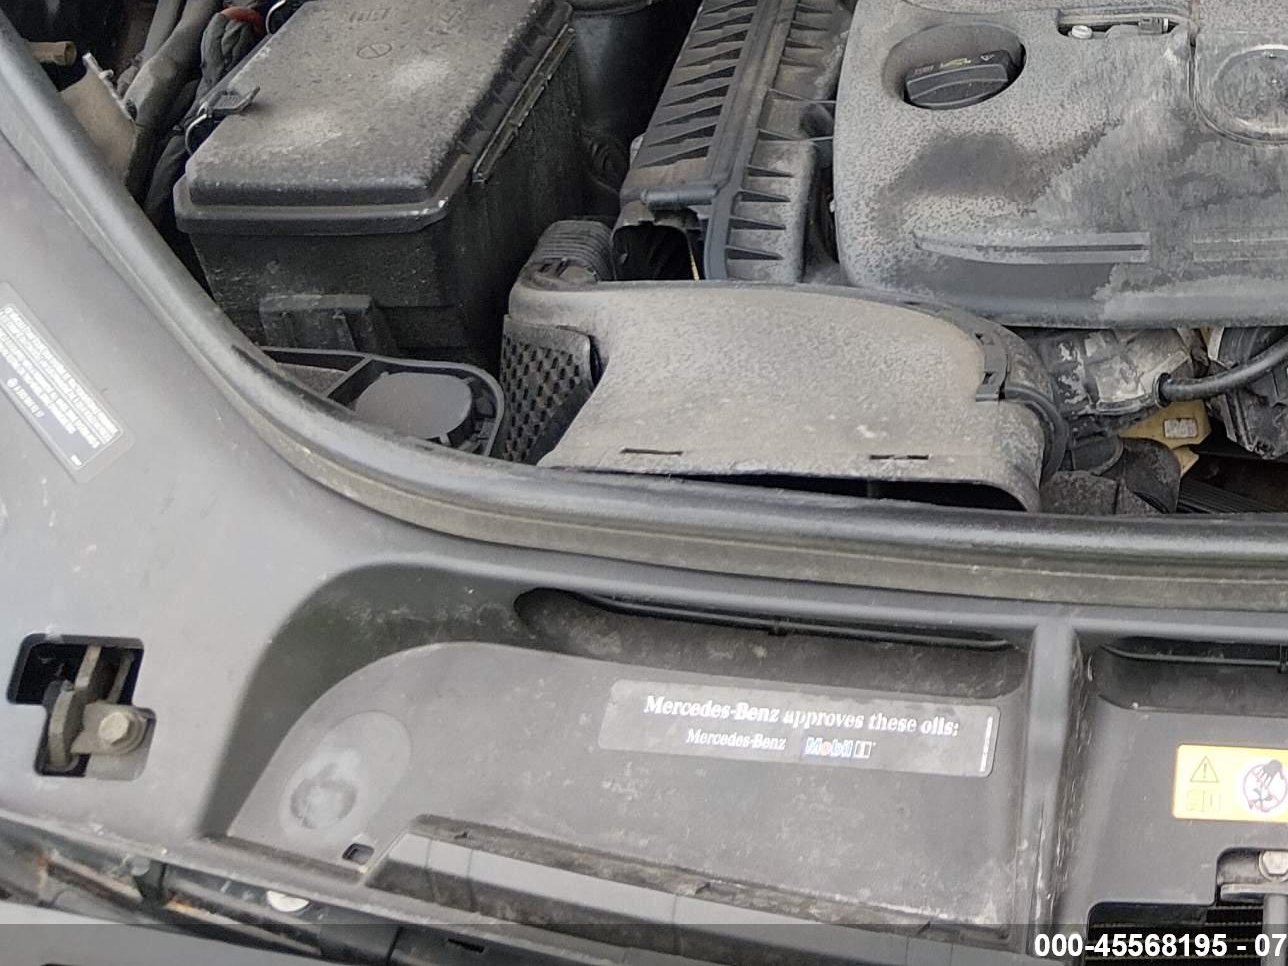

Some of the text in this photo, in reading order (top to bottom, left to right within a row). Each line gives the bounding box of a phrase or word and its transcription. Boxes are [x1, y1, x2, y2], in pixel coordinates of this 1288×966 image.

[643, 695, 781, 724] Mercedes-Benz
[783, 708, 865, 730] approves
[868, 712, 919, 732] these
[685, 728, 787, 751] Mercedes-Benz
[804, 736, 853, 759] Mobil
